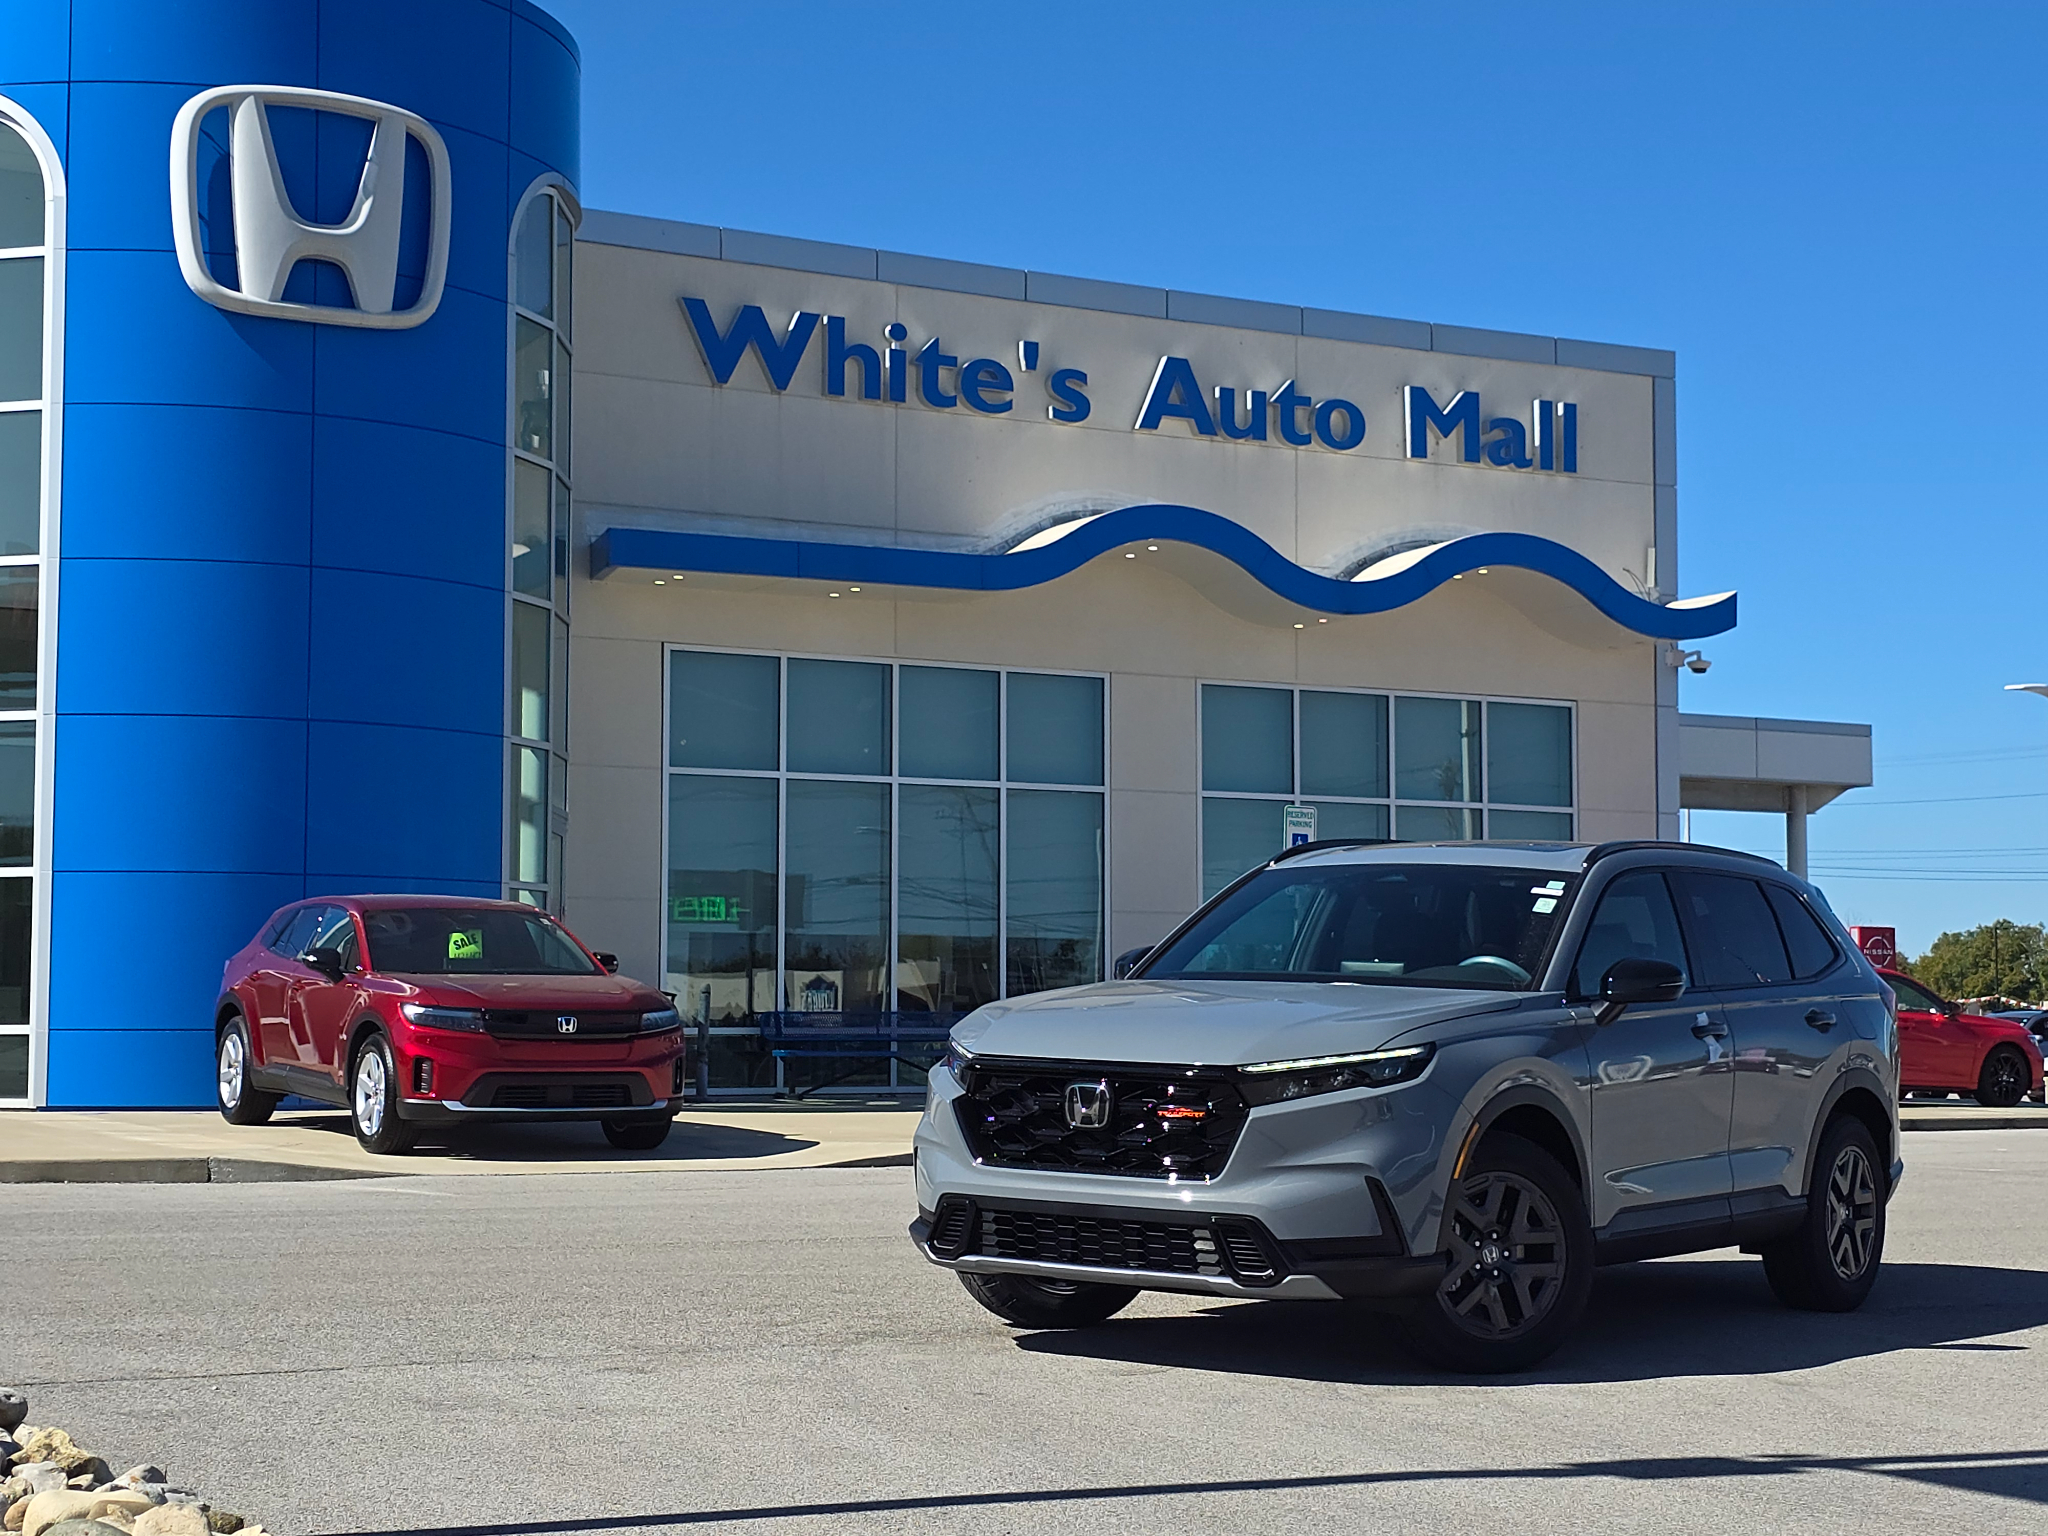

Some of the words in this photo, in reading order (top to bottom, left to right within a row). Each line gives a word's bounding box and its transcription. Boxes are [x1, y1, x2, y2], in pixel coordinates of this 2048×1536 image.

[681, 297, 1091, 424] White's
[1134, 355, 1366, 451] Auto
[1403, 384, 1578, 474] Mall
[1288, 819, 1312, 829] PARKING
[453, 933, 479, 951] SALE
